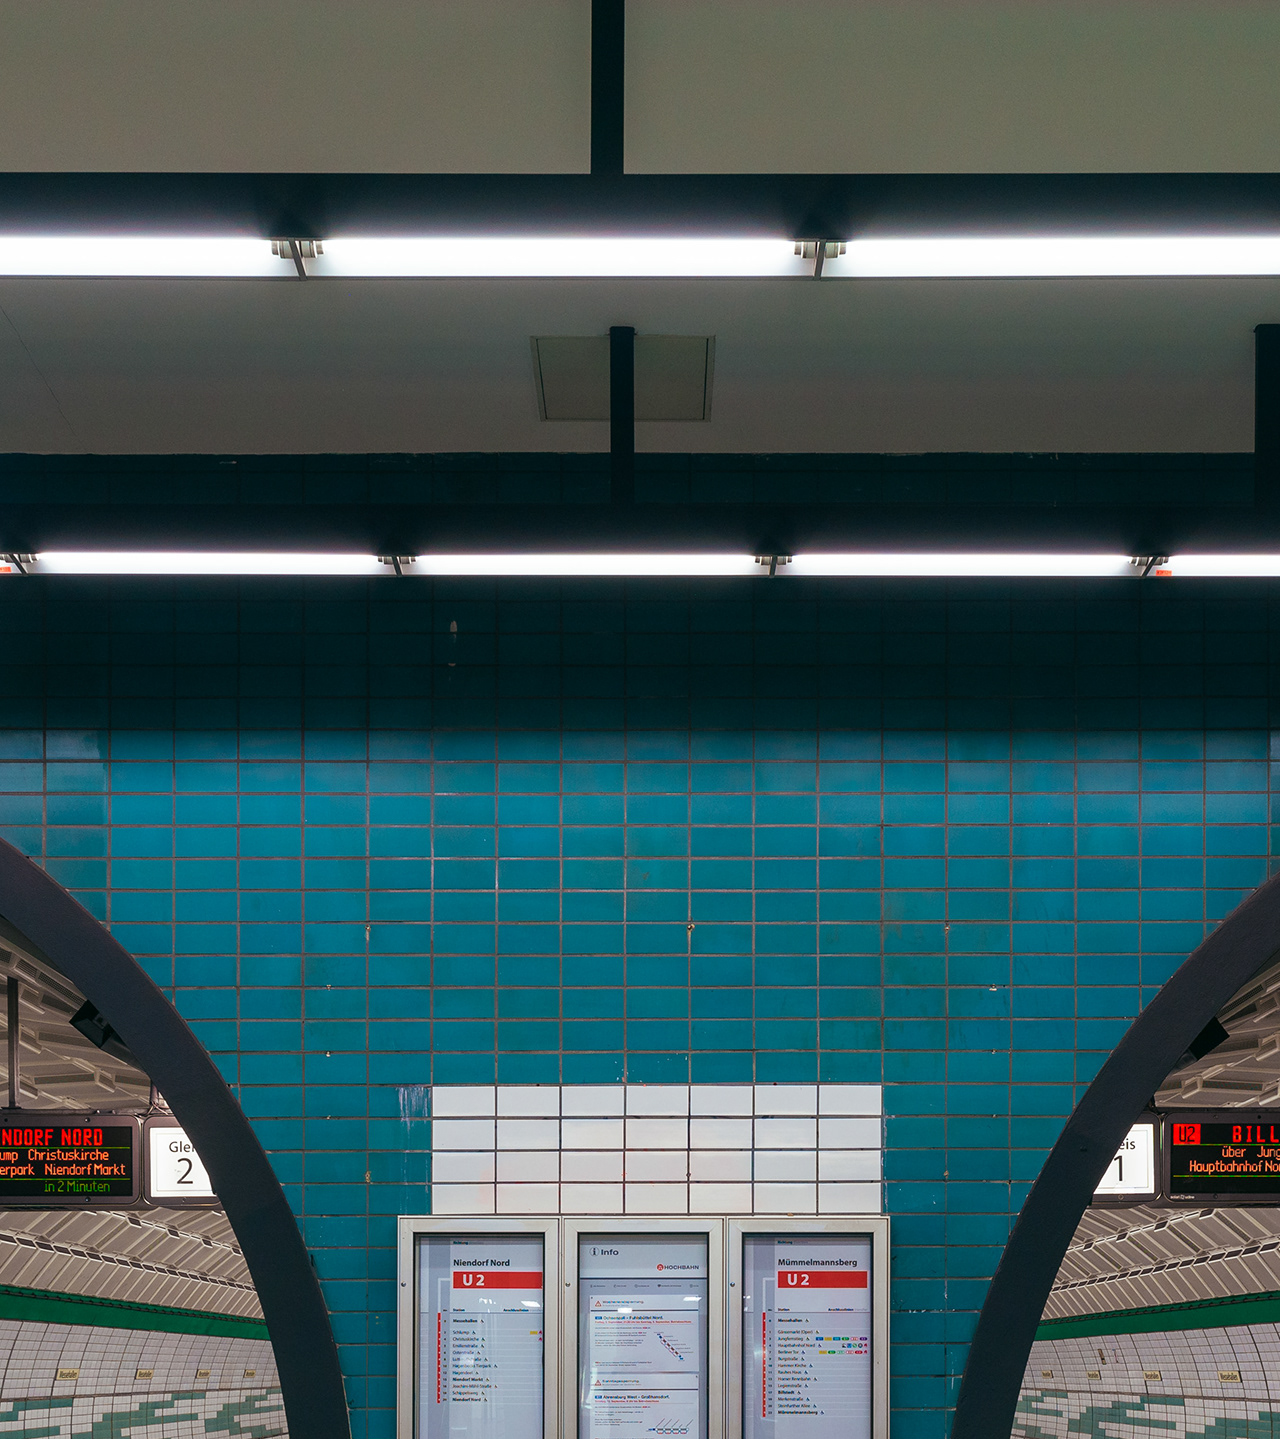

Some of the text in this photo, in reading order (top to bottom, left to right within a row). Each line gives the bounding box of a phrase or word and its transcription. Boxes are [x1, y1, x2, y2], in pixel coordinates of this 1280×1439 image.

[61, 1128, 103, 1146] NORD
[1178, 1126, 1196, 1143] U2
[168, 1140, 195, 1153] Gle
[1119, 1138, 1136, 1150] eis
[28, 1148, 109, 1161] Christuskirche
[1222, 1145, 1246, 1158] über
[44, 1163, 92, 1175] Niendorf
[93, 1163, 126, 1175] Markt
[177, 1157, 194, 1184] 2
[1113, 1155, 1123, 1182] 1
[1189, 1160, 1264, 1175] Hauptbahnhof
[44, 1180, 111, 1192] in 2 Minuten
[778, 1258, 858, 1267] Mümmelmannsberg
[462, 1274, 485, 1286] U 2
[787, 1273, 810, 1286] U 2
